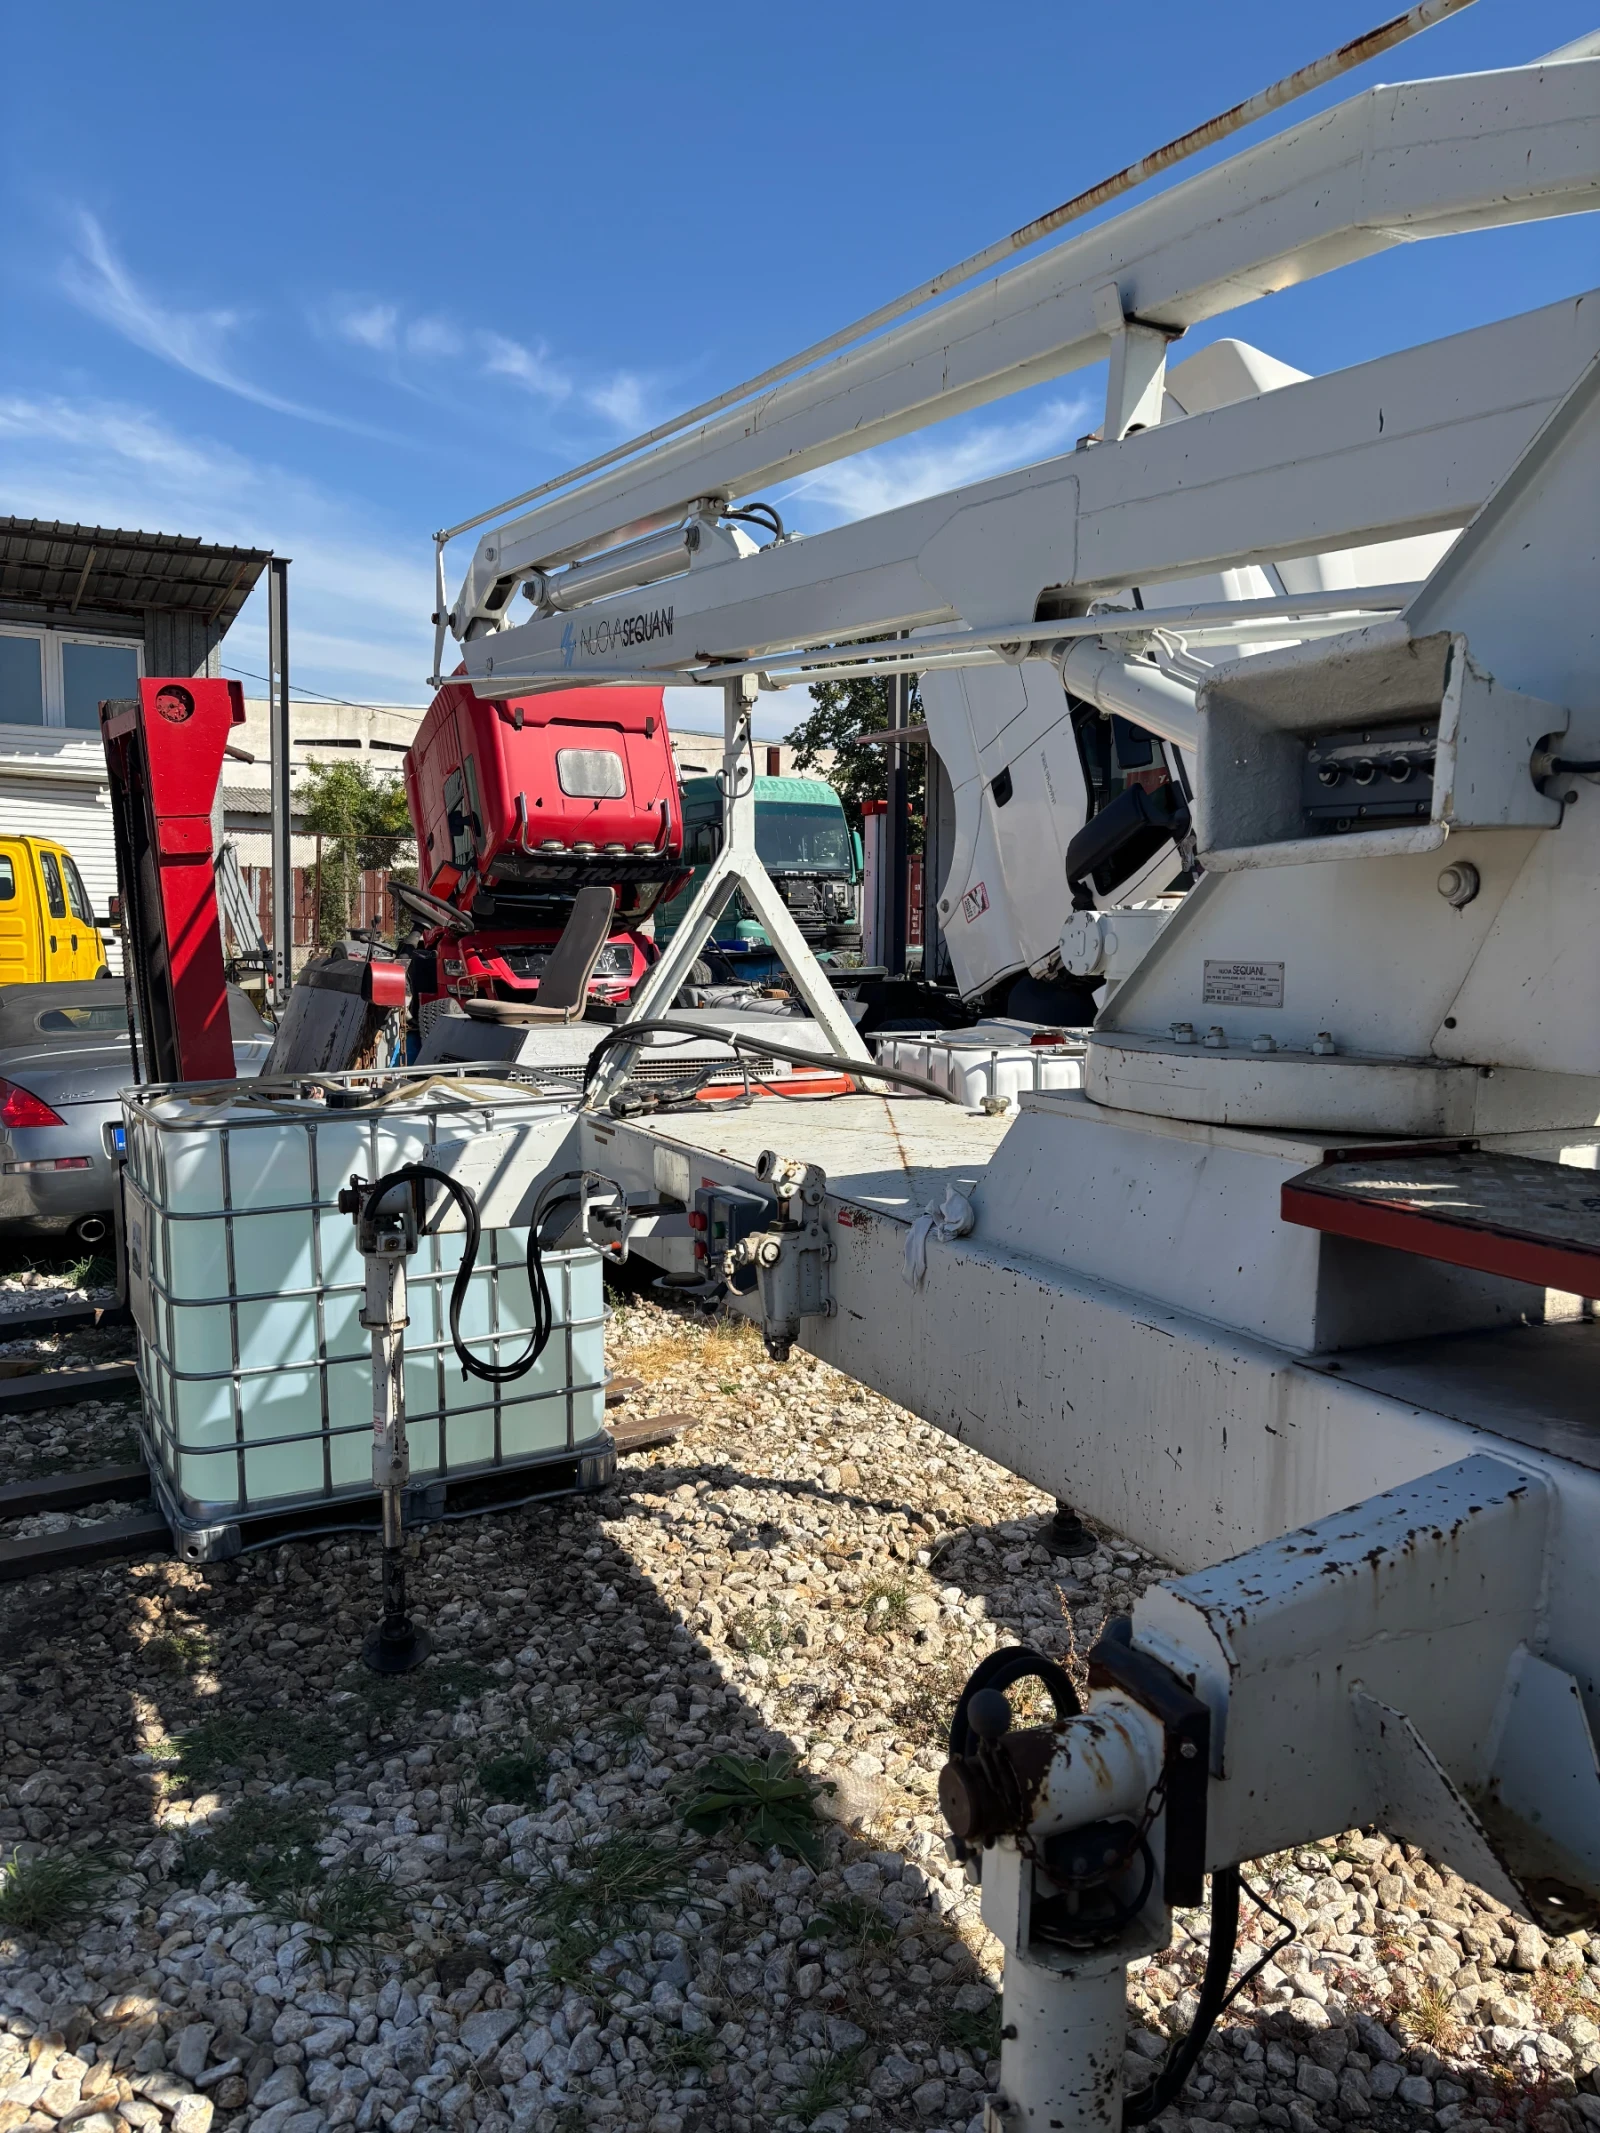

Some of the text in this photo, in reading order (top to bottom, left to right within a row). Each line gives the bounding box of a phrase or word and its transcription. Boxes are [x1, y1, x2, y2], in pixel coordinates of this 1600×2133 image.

[525, 865, 577, 879] RSB
[579, 866, 658, 881] TRANS
[1232, 965, 1264, 975] SEQUANI
